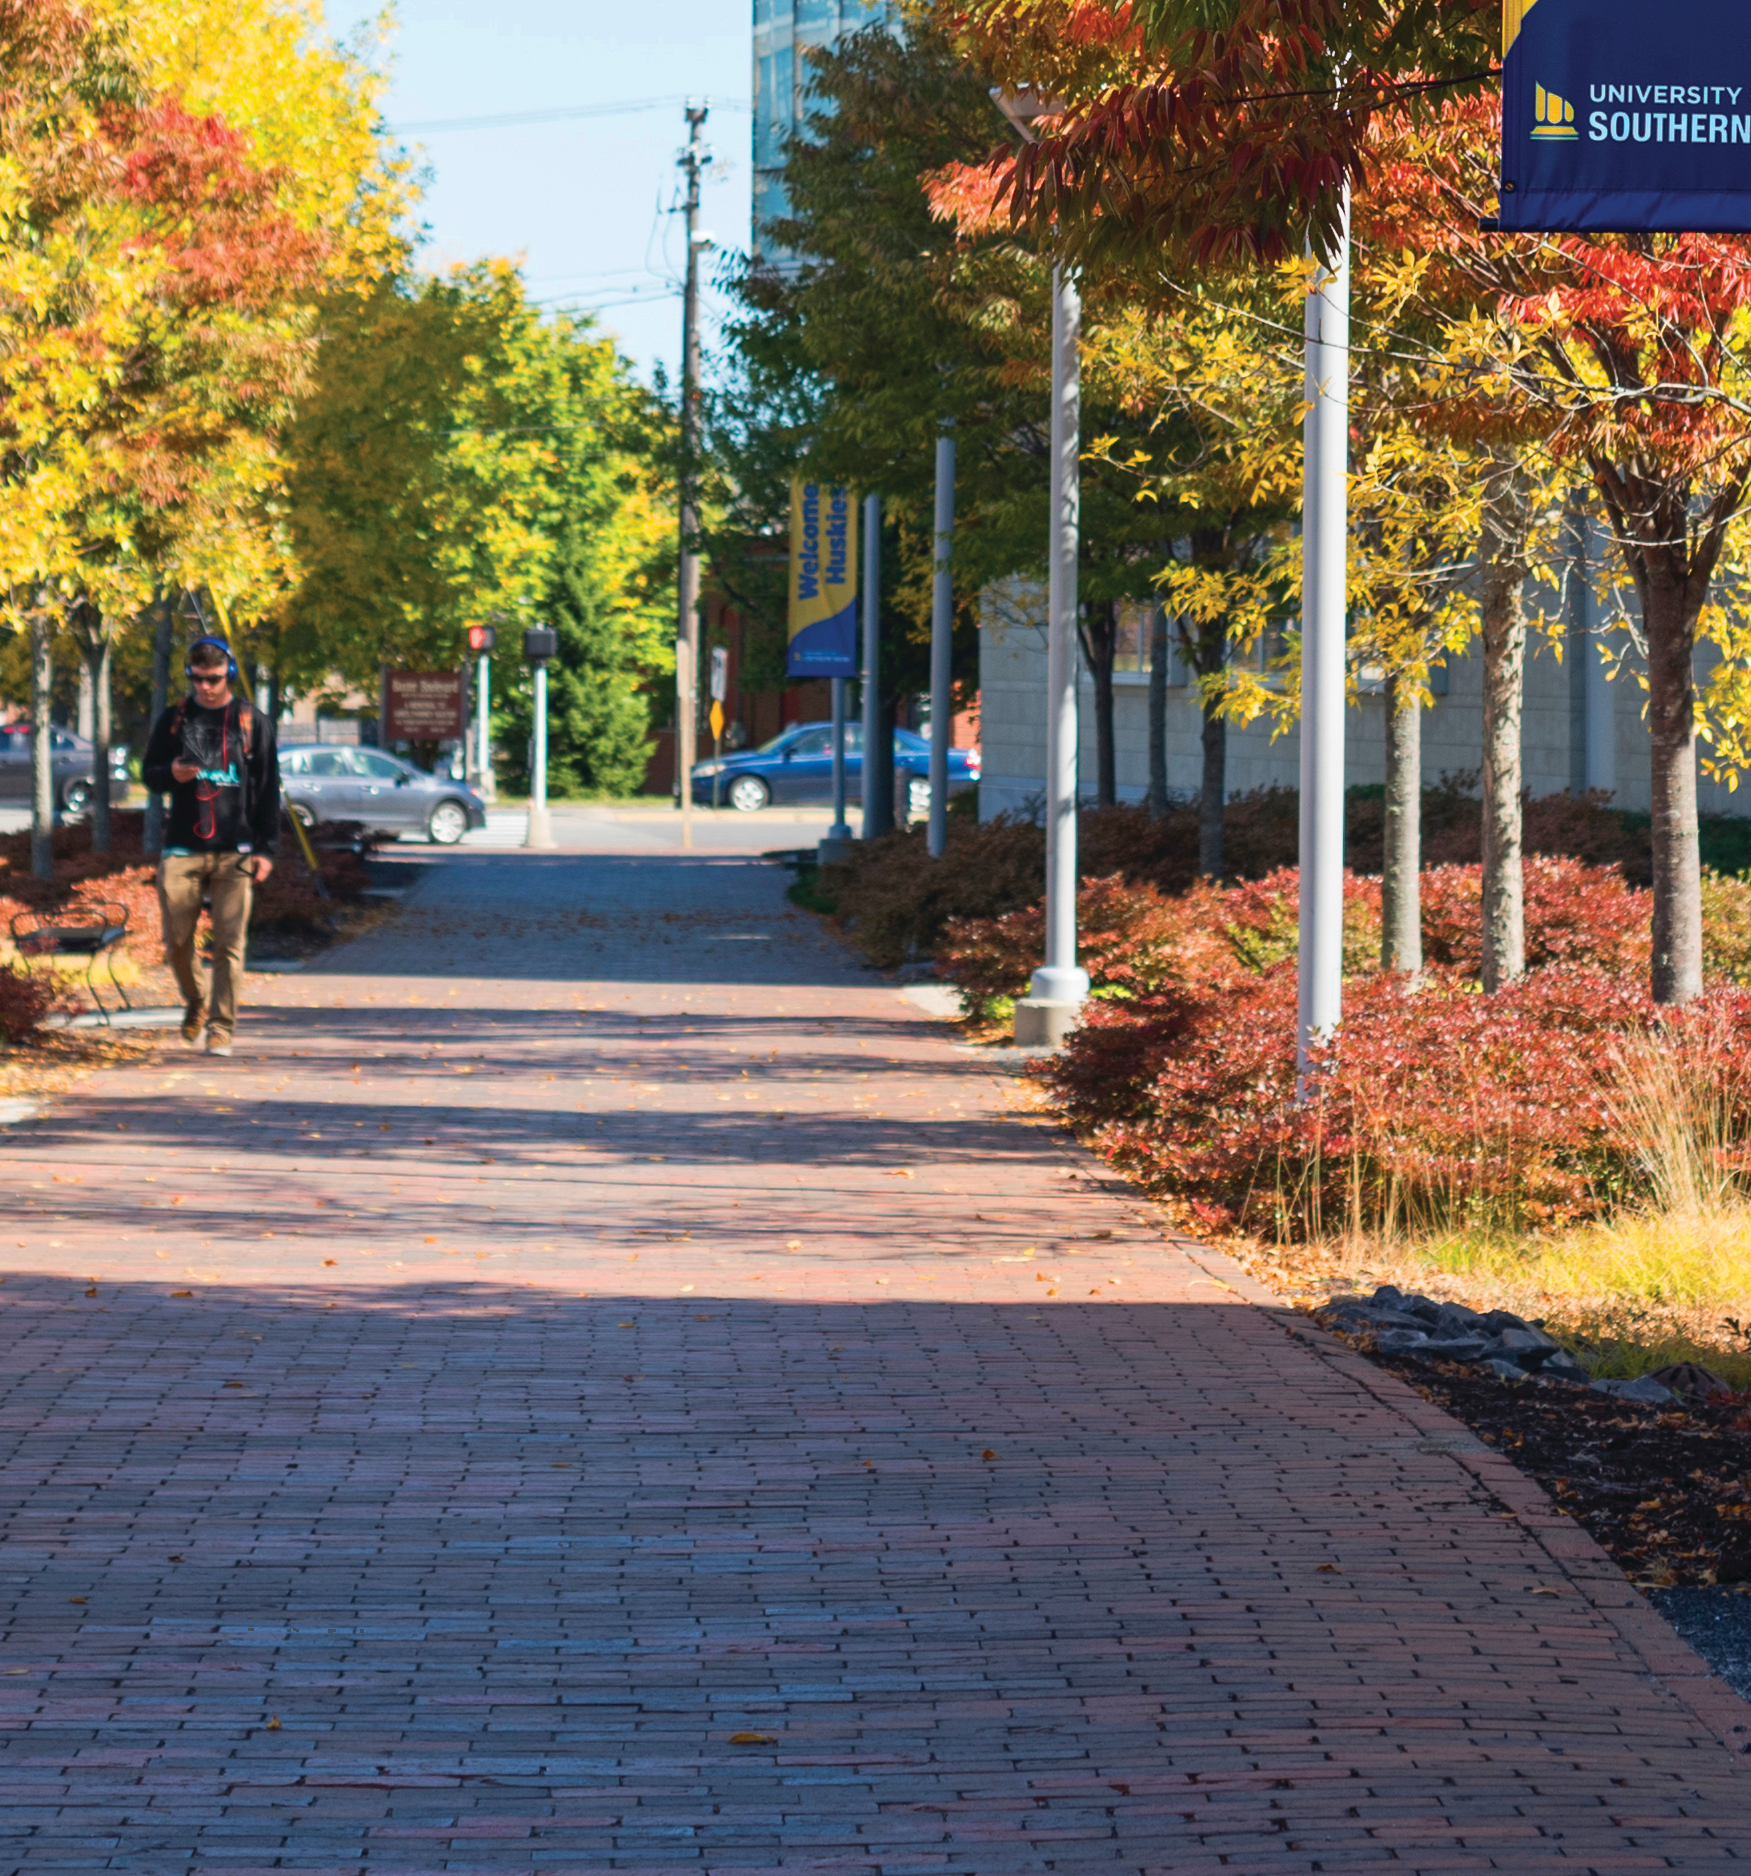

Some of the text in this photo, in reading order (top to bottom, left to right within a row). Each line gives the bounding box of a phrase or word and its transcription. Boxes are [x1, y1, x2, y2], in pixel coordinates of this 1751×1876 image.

[1589, 84, 1742, 105] UNIVERSITY
[1588, 111, 1751, 144] SOUTHERN
[798, 483, 819, 600] Welcome
